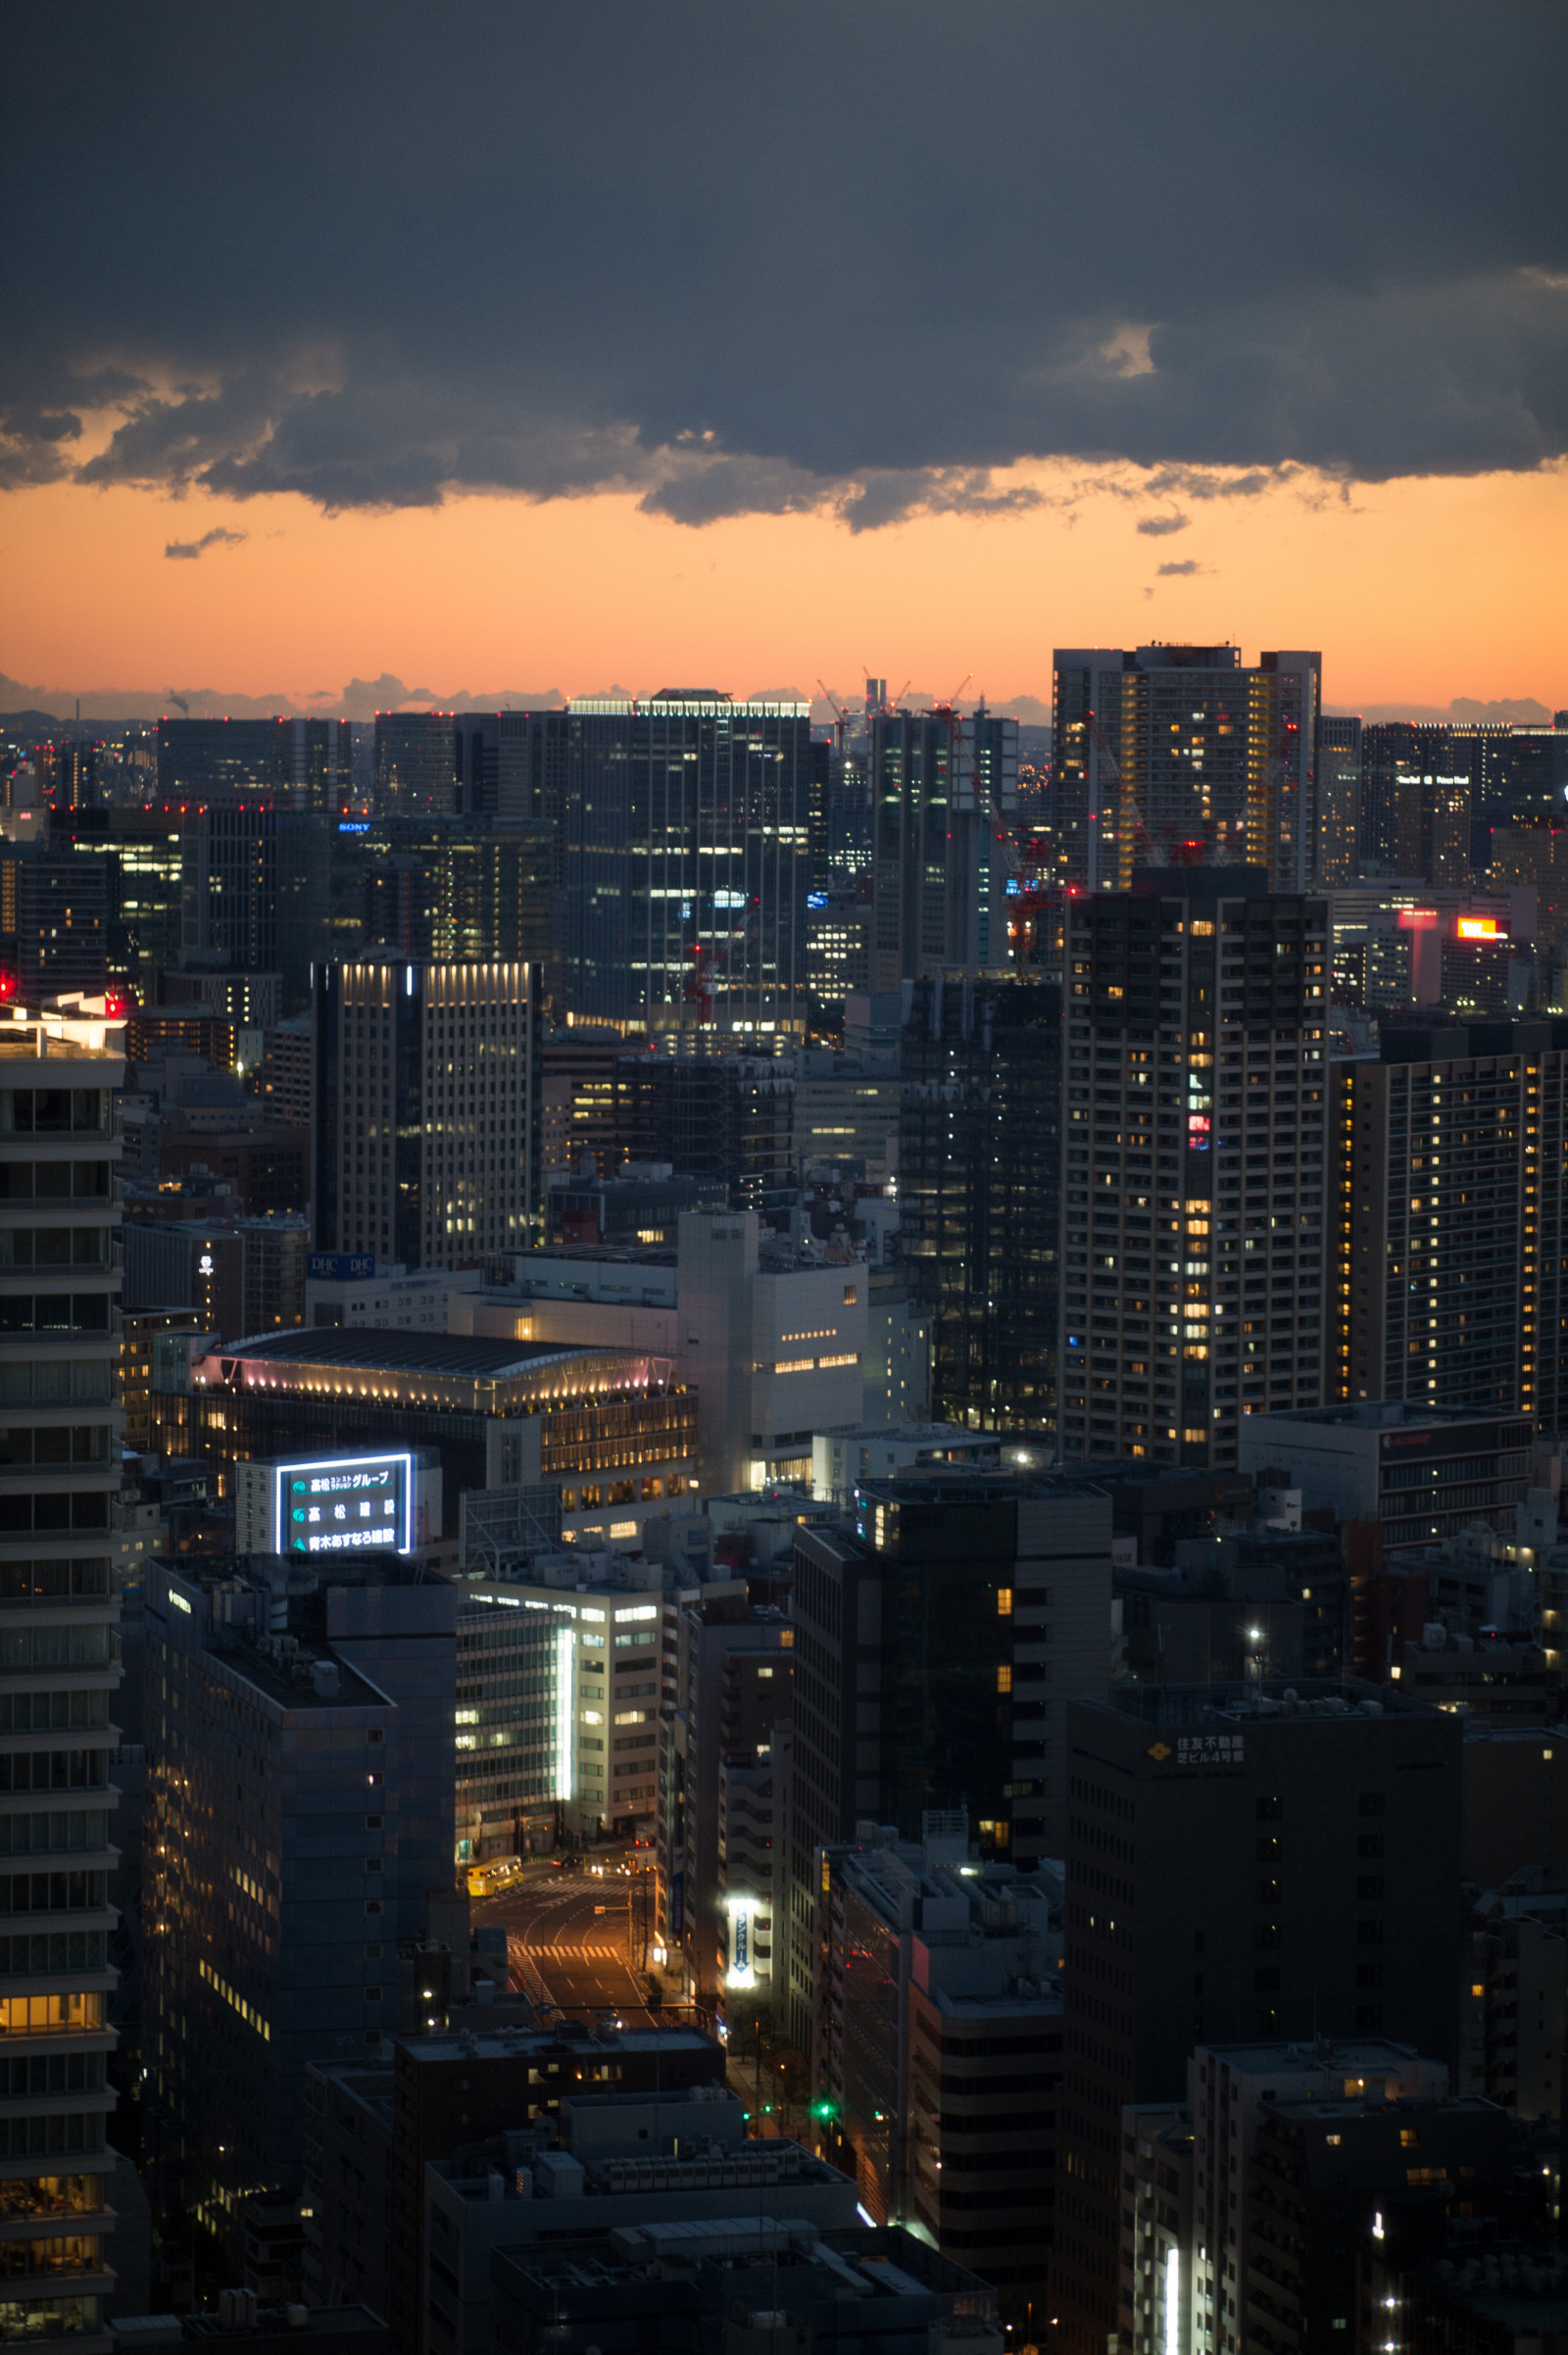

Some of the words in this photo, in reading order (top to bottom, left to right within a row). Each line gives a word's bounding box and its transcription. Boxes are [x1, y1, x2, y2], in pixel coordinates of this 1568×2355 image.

[339, 823, 370, 832] SONY
[312, 1257, 338, 1271] DHC
[350, 1257, 372, 1271] DHC
[736, 1905, 747, 1968] ランクルーム
